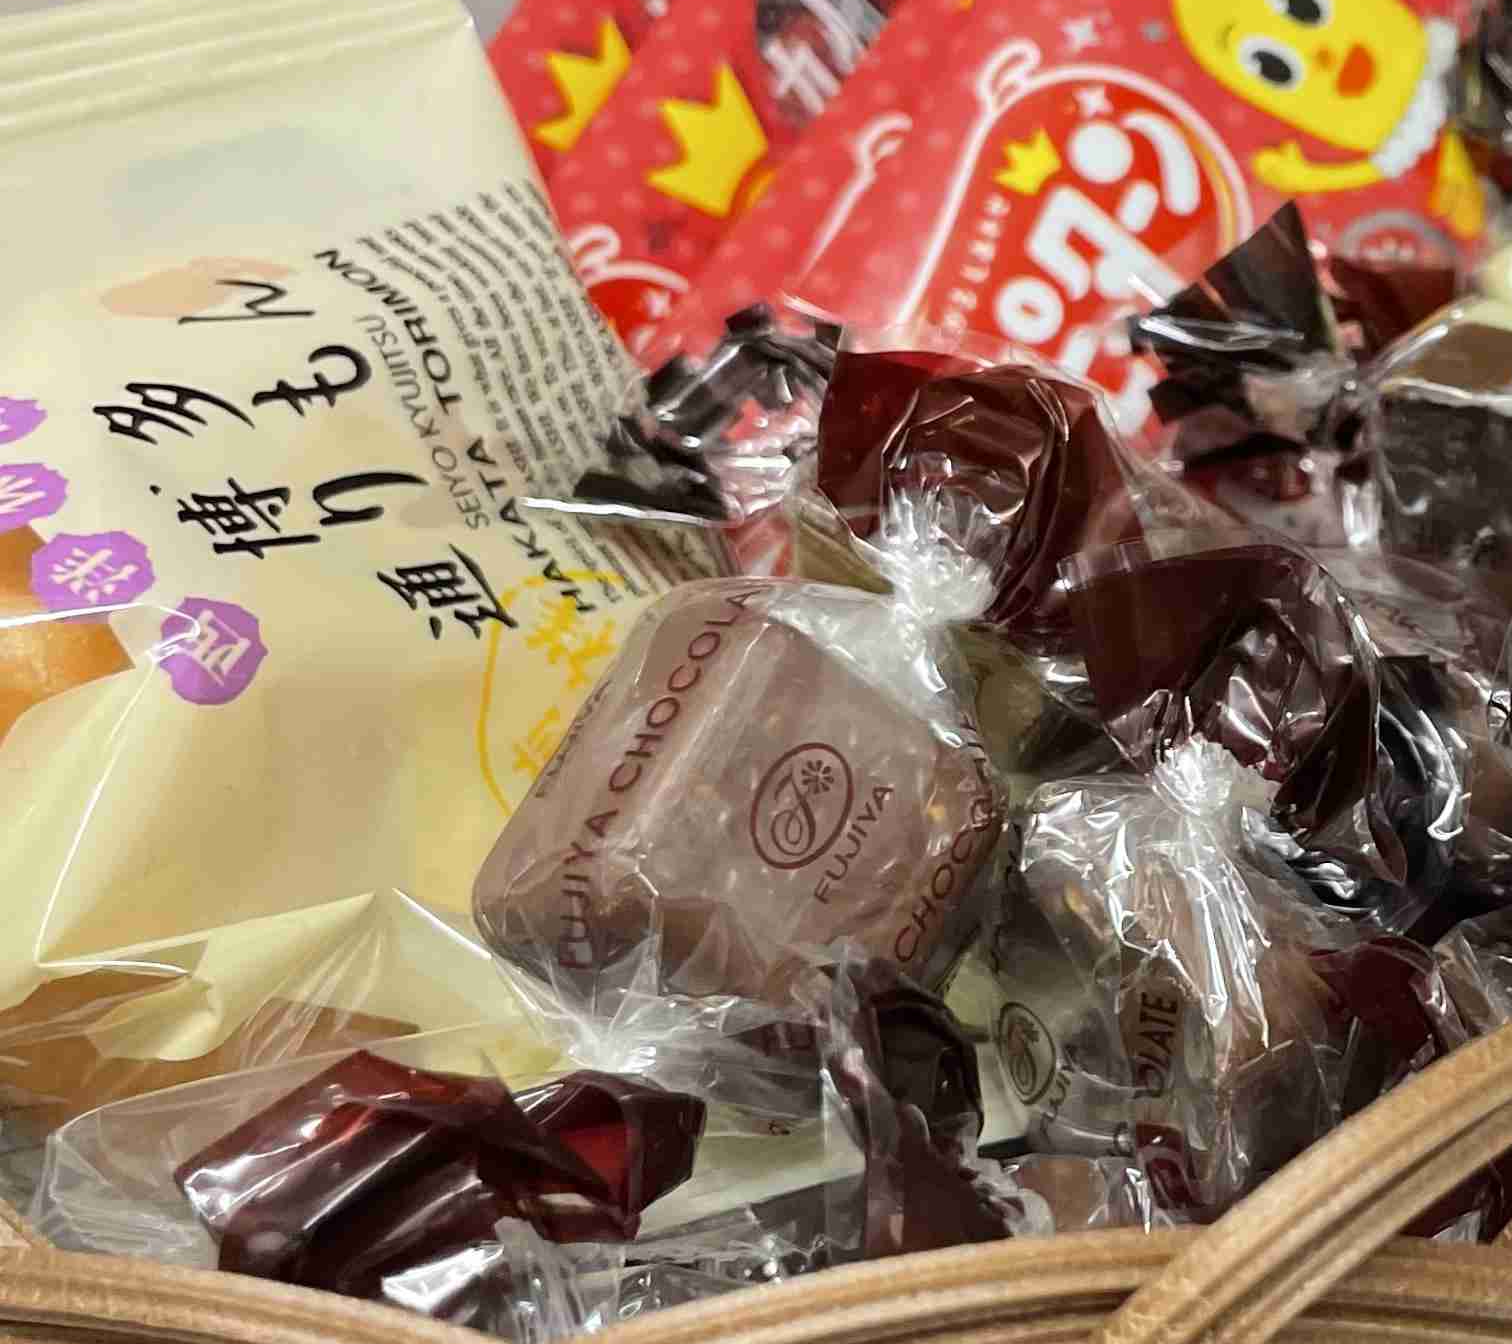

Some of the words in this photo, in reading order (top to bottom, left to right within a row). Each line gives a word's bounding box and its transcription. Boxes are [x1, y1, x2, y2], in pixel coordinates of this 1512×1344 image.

[314, 248, 468, 416] TORIMON
[93, 383, 322, 559] 博多
[178, 278, 519, 640] 通りもん
[430, 444, 490, 532] SEIYO
[466, 437, 602, 614] HAKATA
[813, 783, 894, 904] FUJIYA
